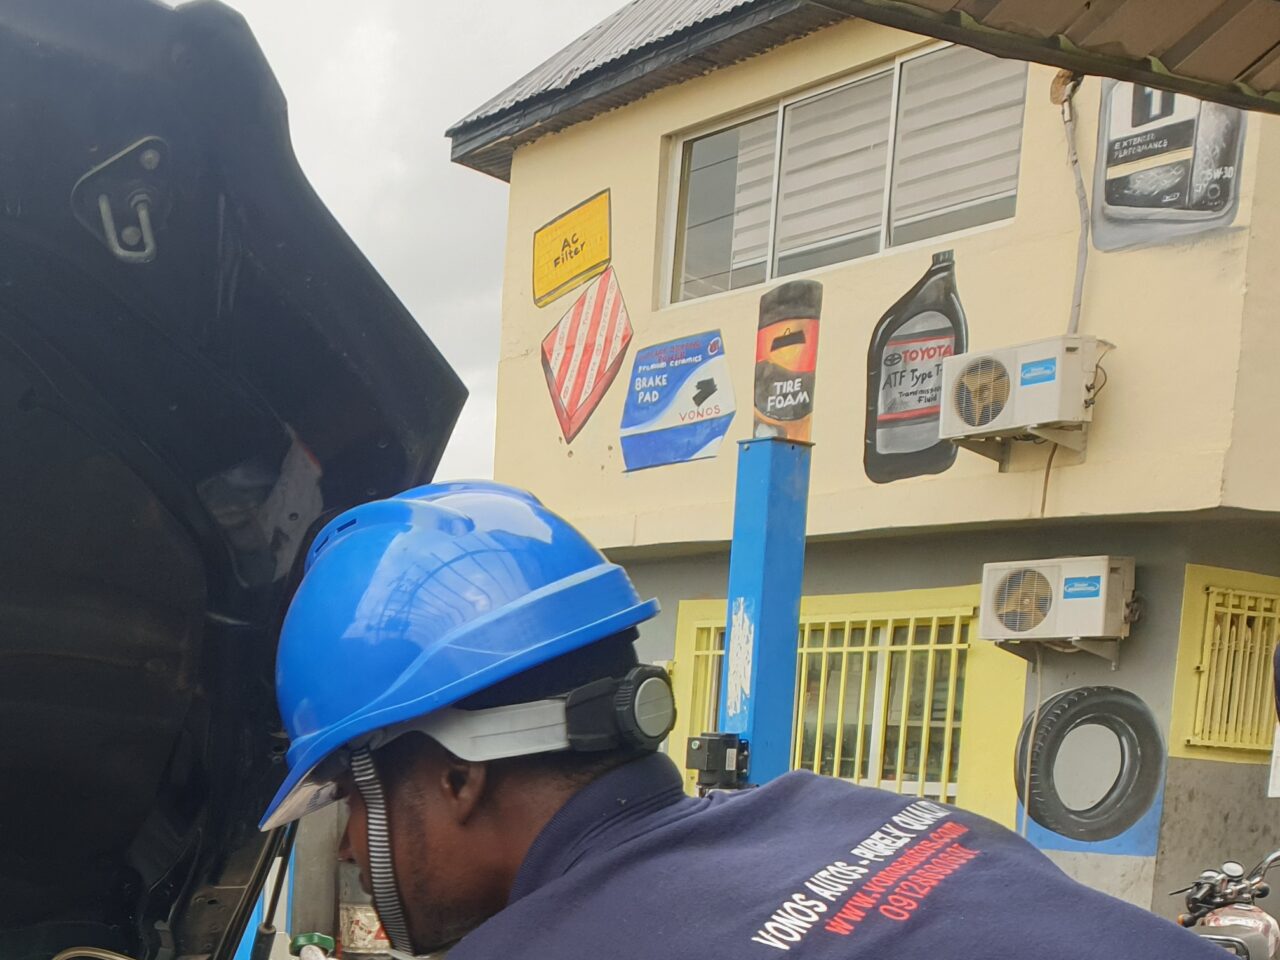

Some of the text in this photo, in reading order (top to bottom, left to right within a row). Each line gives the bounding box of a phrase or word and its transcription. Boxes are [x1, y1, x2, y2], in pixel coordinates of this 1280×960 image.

[561, 232, 580, 252] AC
[553, 240, 586, 268] Filter
[901, 344, 954, 364] TOYOTA
[634, 374, 669, 391] BRAKE
[773, 377, 803, 396] TIRE
[882, 369, 907, 390] ATF
[910, 367, 934, 388] Type
[638, 390, 660, 404] PAD
[767, 391, 810, 412] FOAM
[917, 393, 938, 404] Fluid
[678, 404, 722, 422] VONOS
[750, 893, 829, 951] VONOS
[803, 861, 870, 902] AUTOS
[850, 823, 917, 862] PURELY
[824, 821, 970, 936] www.vonosautos.com
